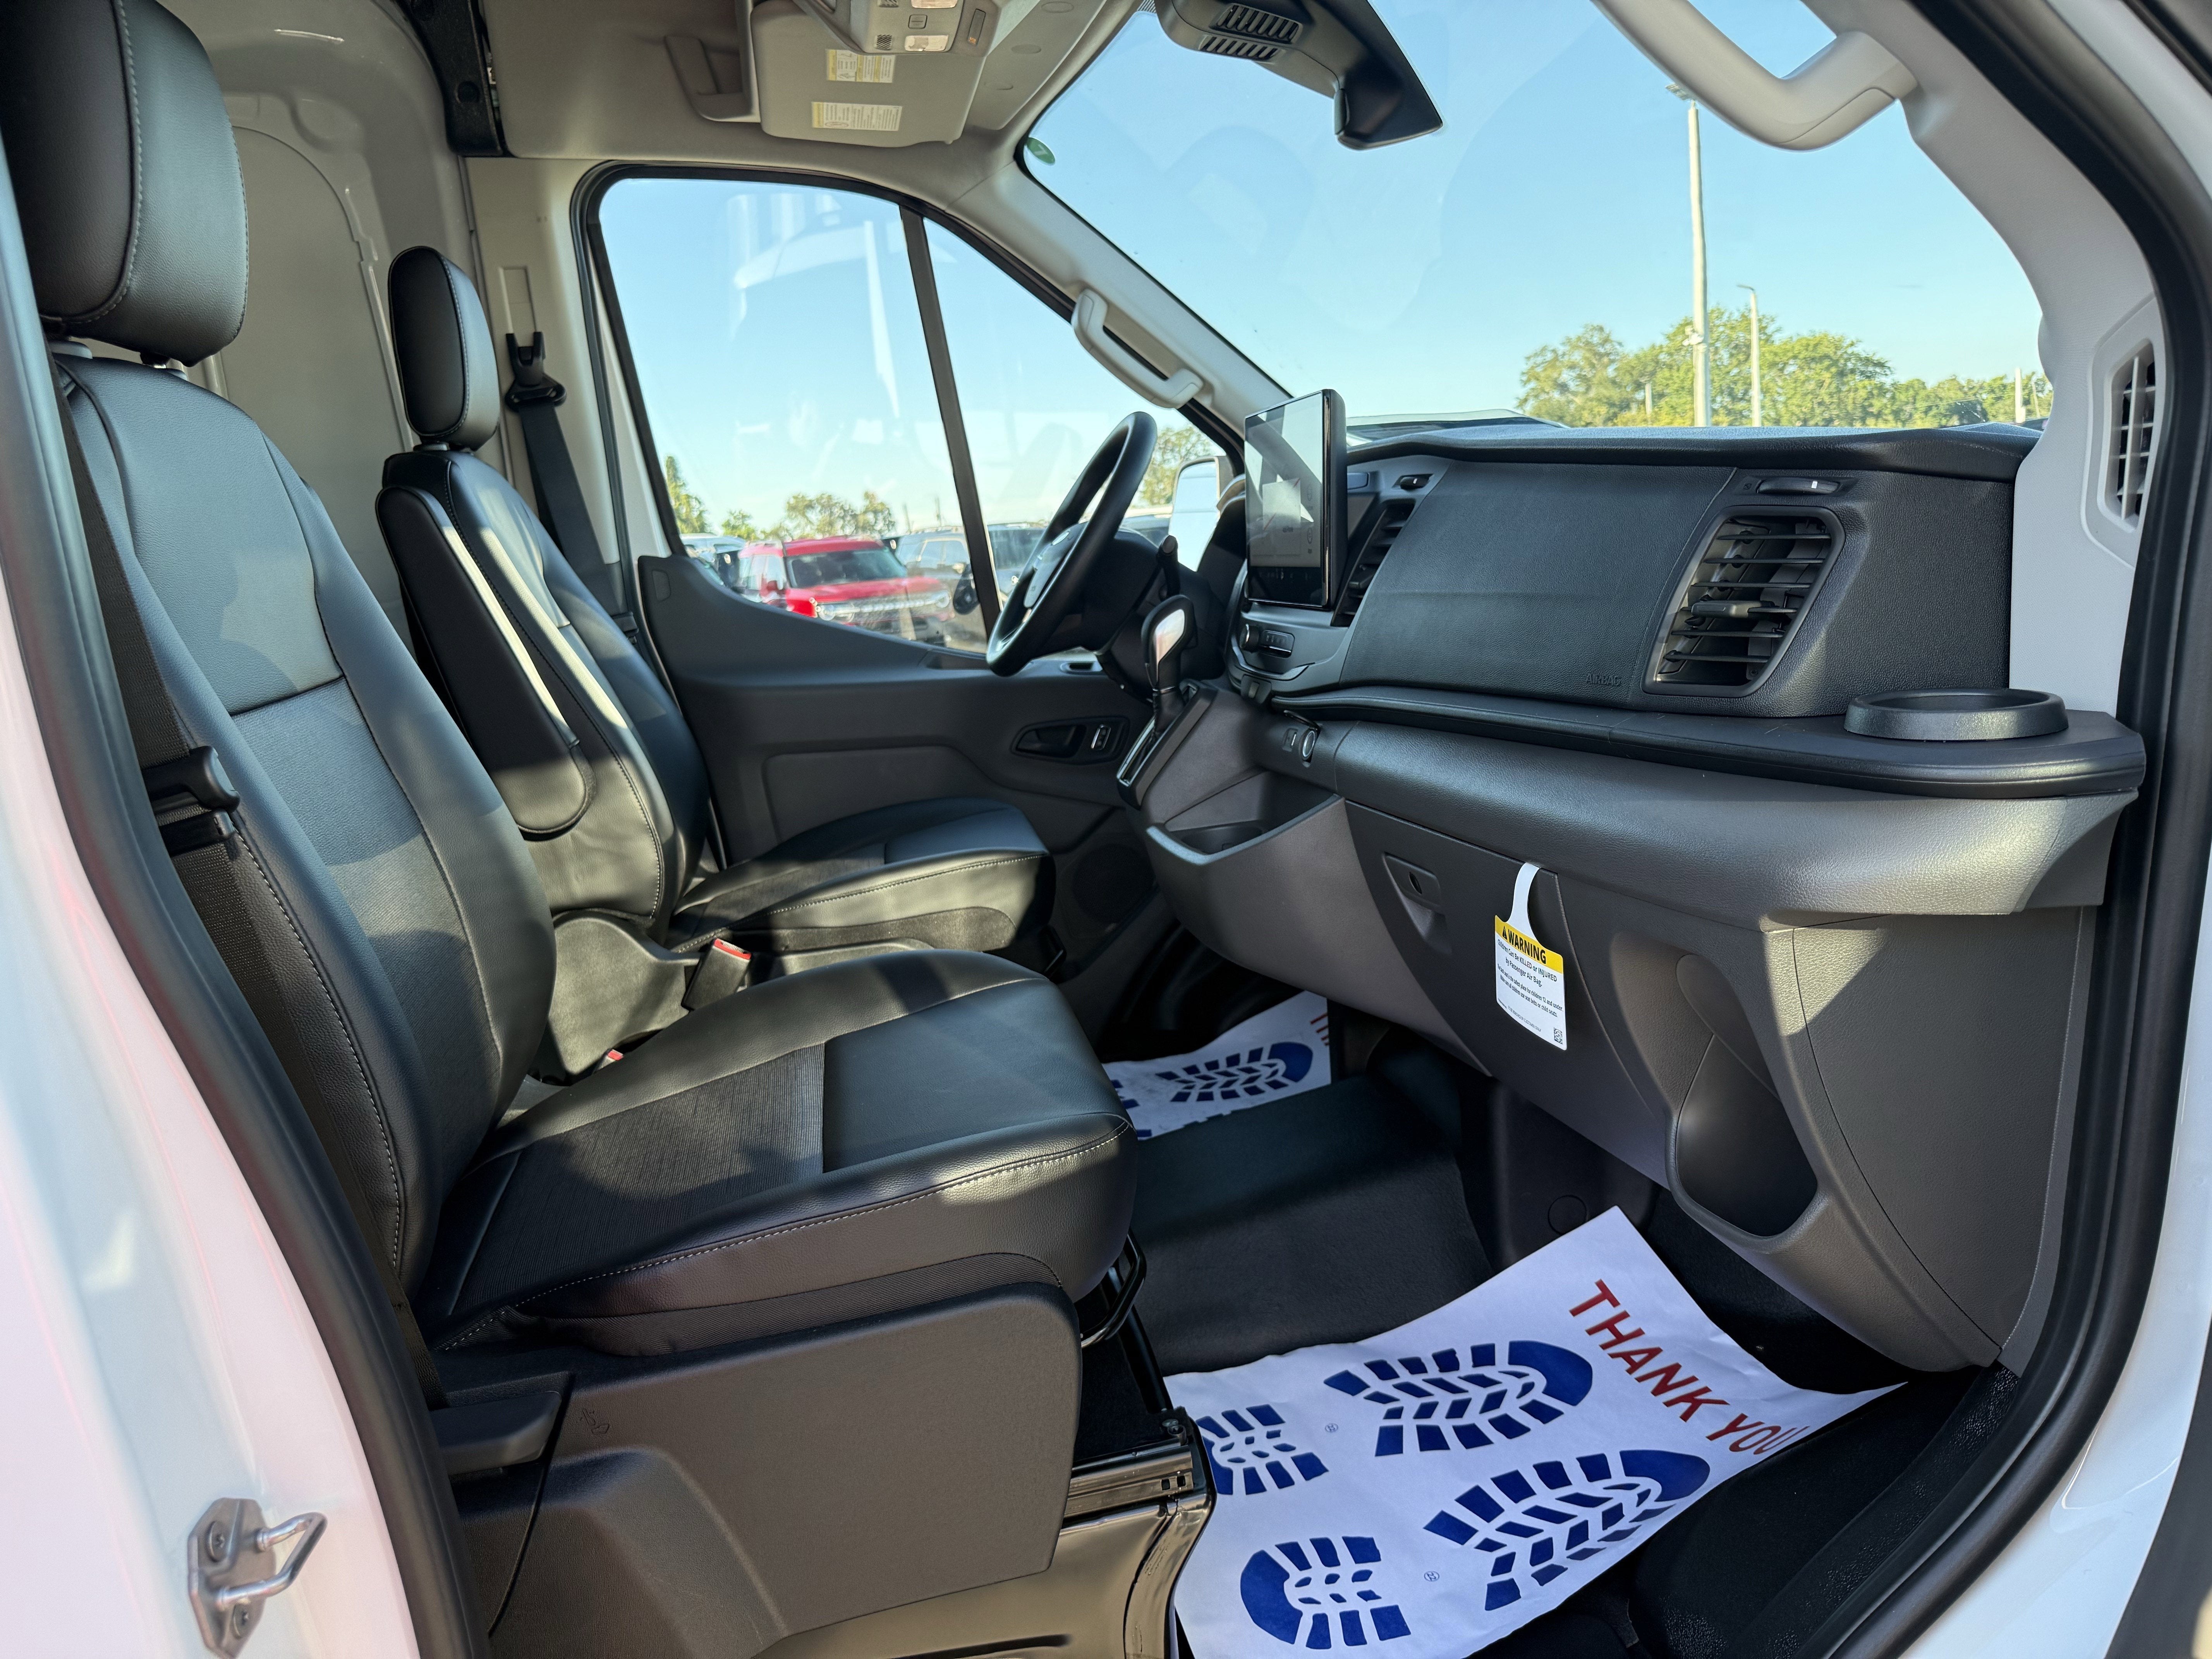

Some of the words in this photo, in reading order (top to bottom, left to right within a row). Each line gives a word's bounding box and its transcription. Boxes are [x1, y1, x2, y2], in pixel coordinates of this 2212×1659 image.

[1587, 673, 1622, 687] AIRBAG
[1508, 929, 1546, 964] WARNING
[1506, 957, 1509, 966] by
[1510, 961, 1526, 976] Passenger
[1515, 953, 1519, 961] Be
[1520, 957, 1532, 969] KILLED
[1539, 968, 1557, 982] INJURED
[1569, 1278, 1731, 1422] THANK
[1705, 1413, 1811, 1455] YOU
